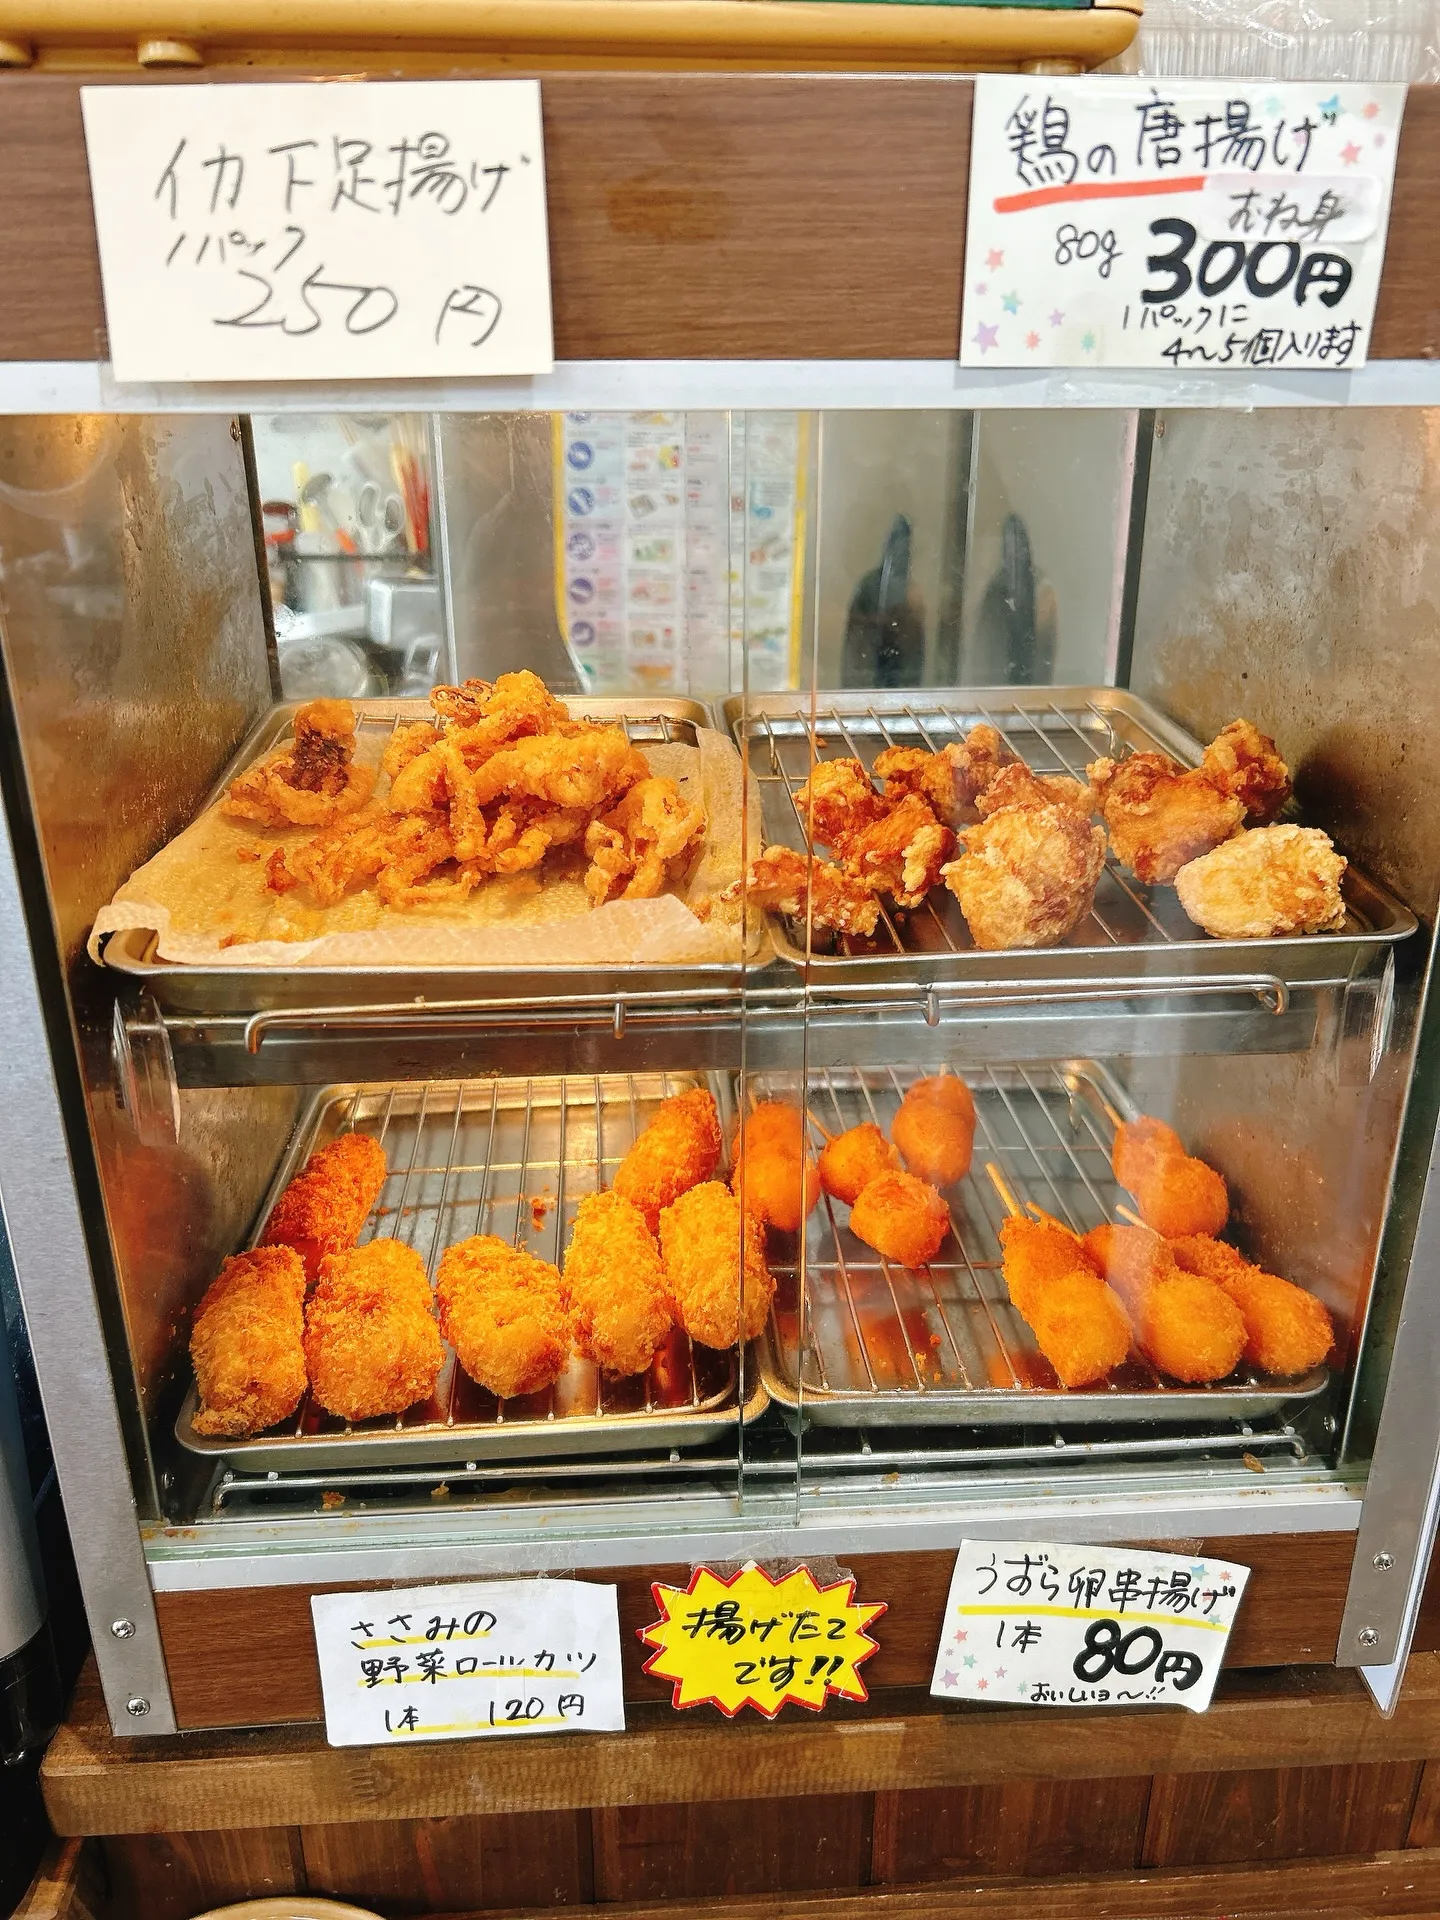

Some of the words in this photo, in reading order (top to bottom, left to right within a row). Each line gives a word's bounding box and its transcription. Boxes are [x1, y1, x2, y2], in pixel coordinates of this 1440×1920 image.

[1006, 86, 1338, 188] 鶏の唐揚げ
[154, 130, 533, 219] イカ下足揚げ
[1227, 187, 1347, 244] むね身
[1055, 223, 1124, 279] 80g
[1140, 217, 1354, 309] 300円
[975, 1552, 1236, 1615] うずら卵串揚げ
[350, 1610, 498, 1650] ささみの
[681, 1600, 847, 1646] 揚げたて
[359, 1648, 597, 1689] 野菜ロールカツ
[1072, 1618, 1204, 1692] 80円
